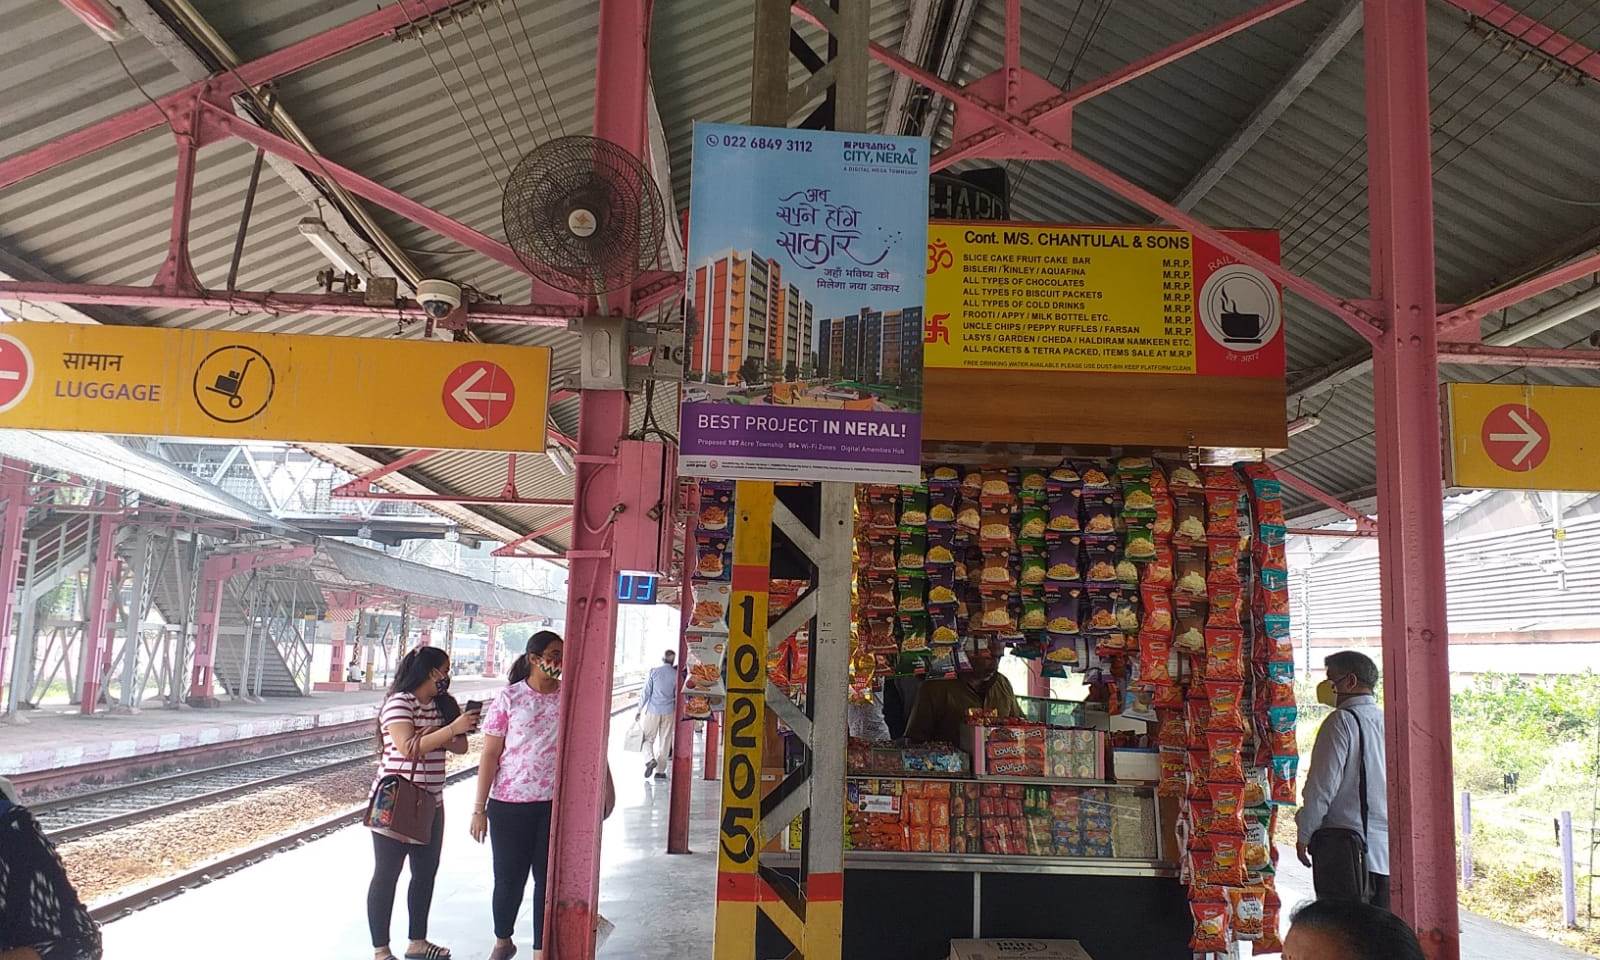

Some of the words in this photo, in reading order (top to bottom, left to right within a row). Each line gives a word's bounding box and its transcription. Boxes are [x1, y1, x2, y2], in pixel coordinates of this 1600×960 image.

[722, 135, 746, 148] 022
[750, 137, 782, 150] 6849
[786, 139, 812, 152] 3112
[844, 150, 873, 163] CITY,
[876, 152, 918, 165] NERAL
[964, 230, 999, 244] Cont.
[1004, 232, 1033, 245] M/S.
[1038, 233, 1128, 248] CHANTULAL
[1132, 236, 1142, 248] &
[1146, 236, 1190, 249] SONS
[963, 254, 988, 262] SLICE
[1044, 256, 1068, 264] CAKE
[1162, 259, 1192, 268] M.R.P.
[1208, 256, 1232, 272] RAIL
[846, 268, 874, 278] भविष्य
[876, 269, 890, 280] को
[963, 264, 996, 272] BISLERI
[1003, 265, 1034, 274] KINLEY
[1041, 267, 1086, 275] AQUAFINA
[1162, 270, 1192, 279] M.R.P.
[816, 278, 846, 290] मिलेगा
[870, 284, 900, 292] आकार
[963, 276, 980, 284] ALL
[982, 277, 1010, 285] TYPES
[1026, 278, 1084, 287] CHOCOLATES
[1163, 282, 1192, 290] M.R.P.
[963, 288, 980, 296] ALL
[982, 288, 1010, 296] TYPES
[1026, 290, 1060, 298] BISCUIT
[1062, 290, 1102, 298] PACKETS
[1164, 294, 1192, 302] M.R.P.
[982, 300, 1010, 308] TYPES
[1052, 302, 1084, 310] DRINKS
[1164, 305, 1193, 313] M.R.P.
[1032, 312, 1052, 320] MILK
[1091, 314, 1112, 322] ETC.
[1164, 316, 1193, 324] M.R.P.
[963, 322, 992, 330] UNCLE
[1028, 324, 1056, 332] PEPPY
[1058, 324, 1098, 332] RUFFLES
[1104, 326, 1140, 334] FARSAN
[1165, 328, 1194, 336] M.R.P.
[998, 334, 1034, 342] GARDEN
[1042, 336, 1072, 344] CHEDA
[1127, 338, 1170, 346] NAMKEEN
[982, 346, 1022, 354] PACKETS
[1024, 346, 1030, 354] &
[1063, 348, 1100, 356] PACKED,
[1104, 348, 1130, 356] ITEMS
[63, 352, 124, 372] सामान
[55, 380, 161, 402] LUGGAGE
[698, 414, 740, 430] BEST
[746, 417, 818, 433] PROJECT
[823, 421, 840, 434] IN
[845, 422, 906, 438] NERAL!
[697, 438, 726, 446] Proposed
[756, 440, 784, 448] Township
[840, 444, 860, 452] Digital
